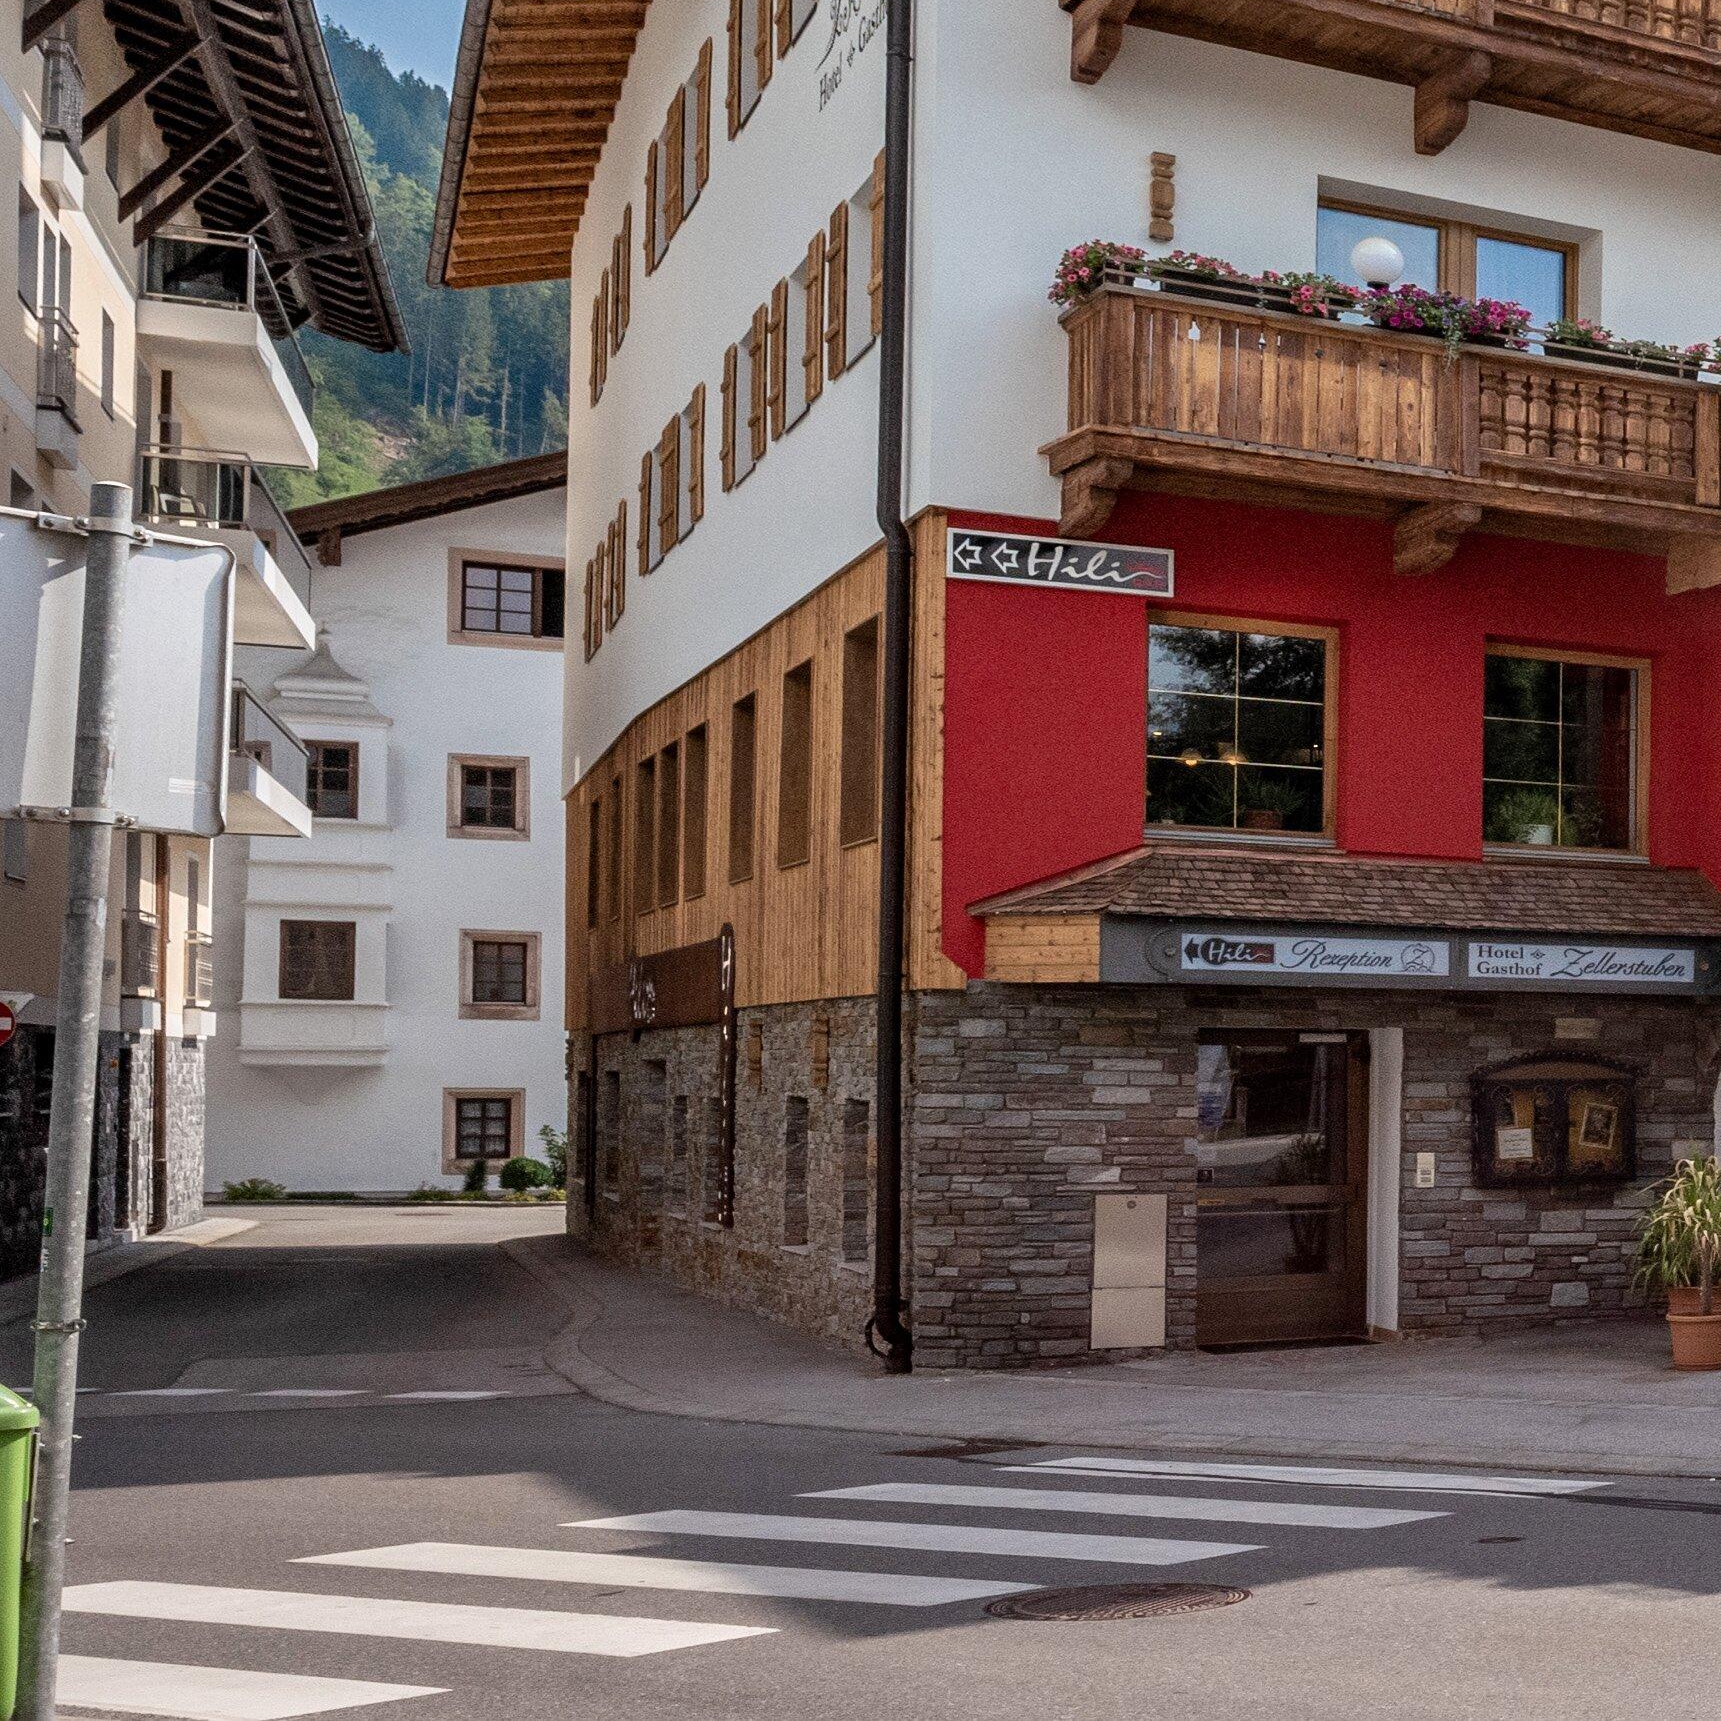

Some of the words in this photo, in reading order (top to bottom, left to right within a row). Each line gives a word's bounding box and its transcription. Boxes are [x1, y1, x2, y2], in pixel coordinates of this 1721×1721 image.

[1027, 542, 1163, 583] Hili
[1208, 940, 1270, 964] Hili
[1280, 939, 1393, 971] Rezeption
[1477, 944, 1524, 960] Hotel
[1550, 948, 1686, 977] Zellerstuben
[1477, 961, 1543, 976] Gasthof
